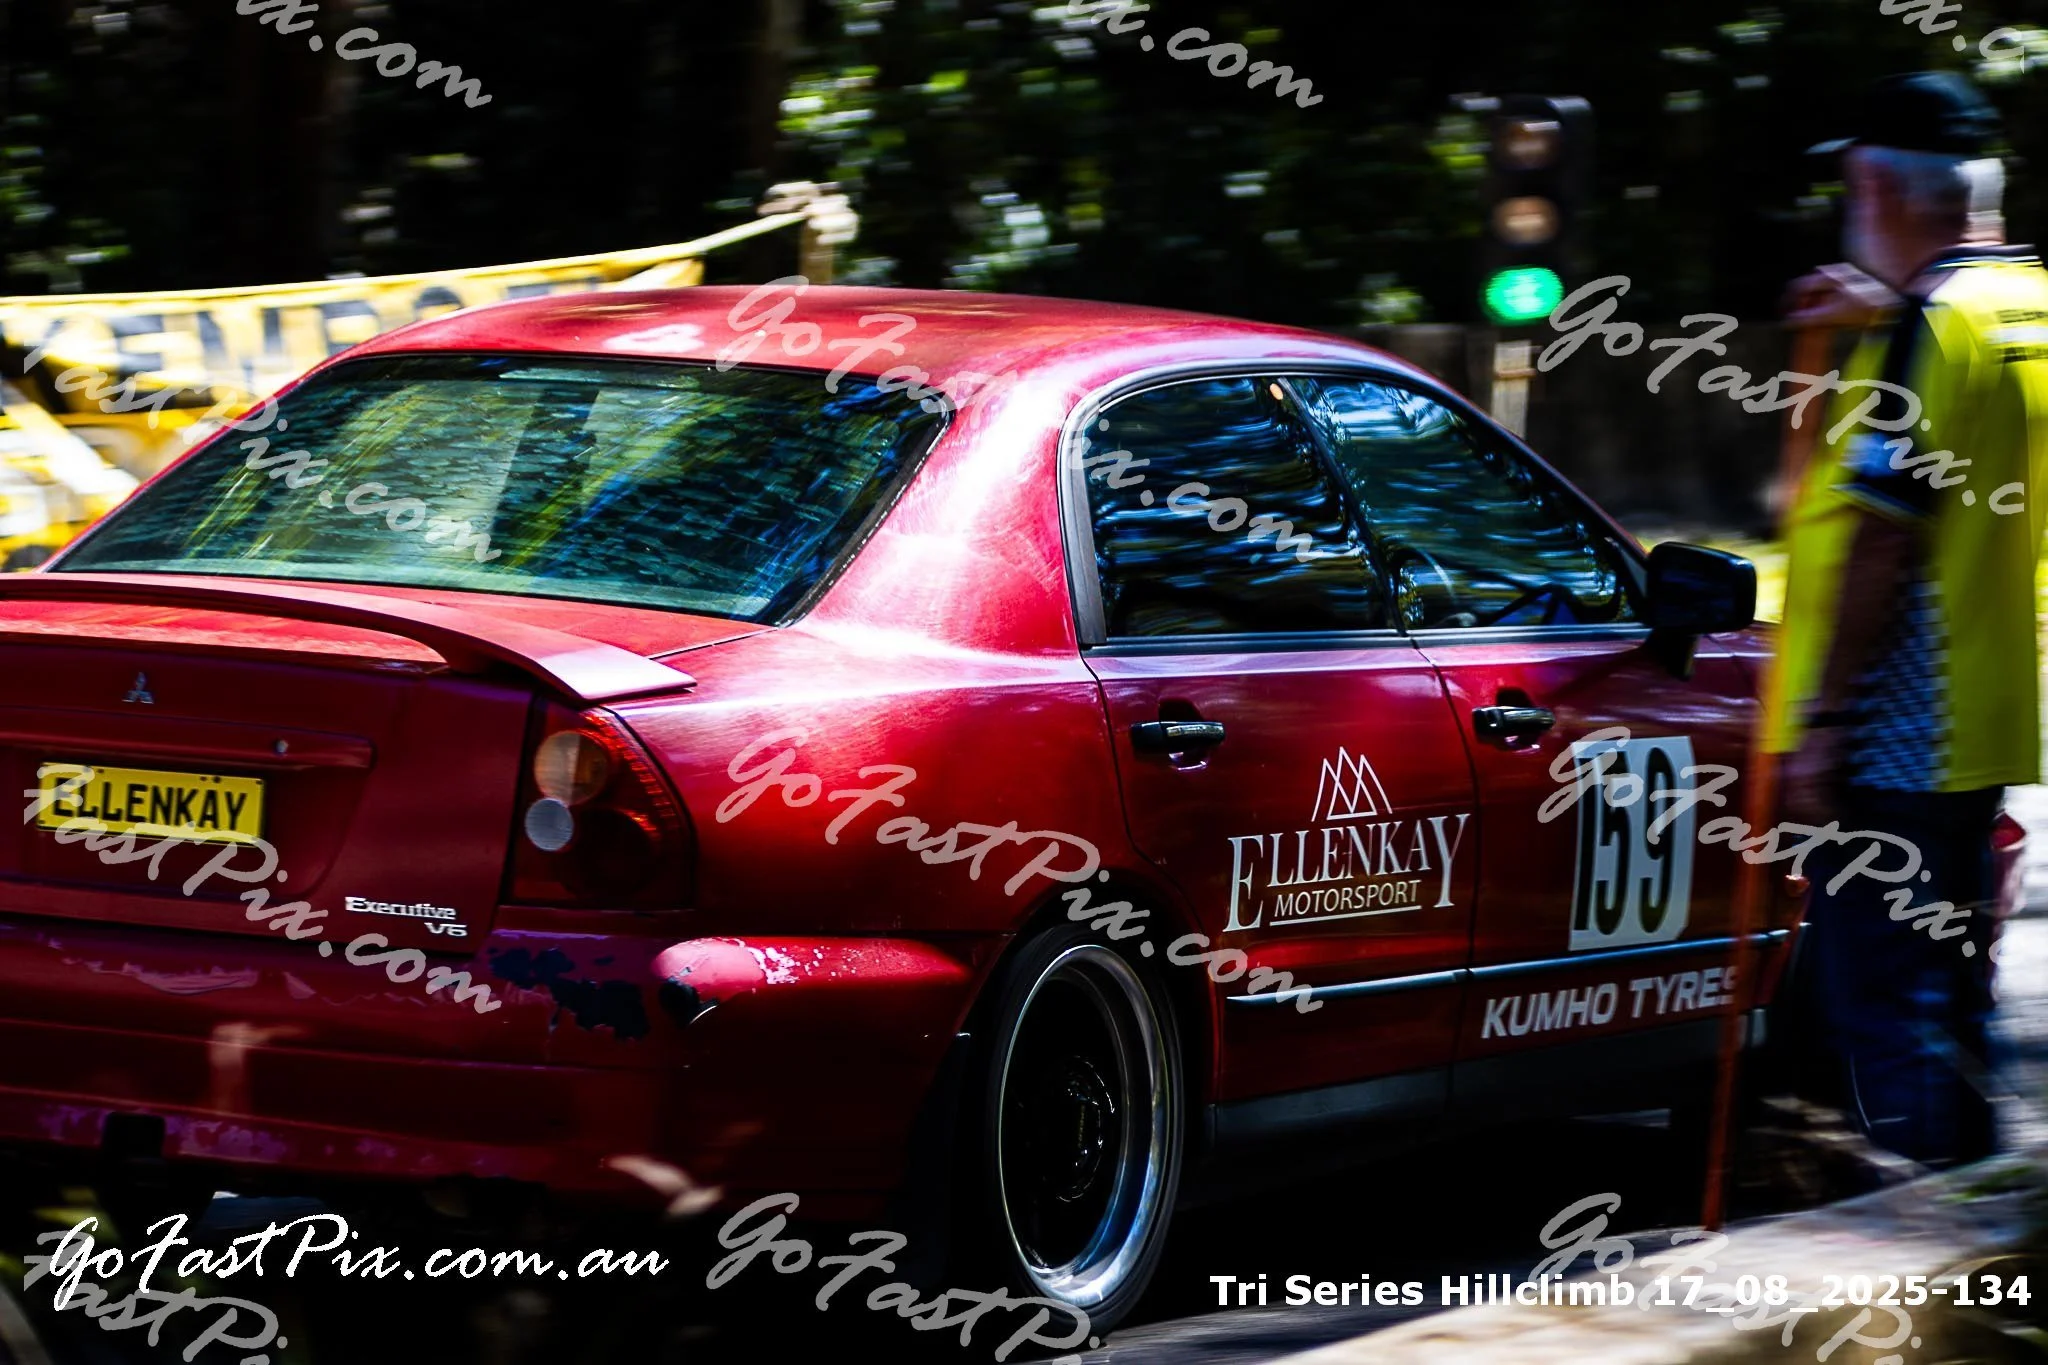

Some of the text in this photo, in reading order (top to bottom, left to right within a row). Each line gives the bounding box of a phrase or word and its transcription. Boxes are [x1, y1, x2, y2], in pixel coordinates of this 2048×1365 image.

[53, 777, 248, 830] ELLENKAY
[1572, 747, 1676, 936] 159
[1223, 813, 1471, 932] ELLENKAY
[1274, 880, 1422, 917] MOTORSPORT
[345, 896, 456, 920] Executive
[424, 922, 468, 937] V6
[1481, 983, 1618, 1039] KUMHO
